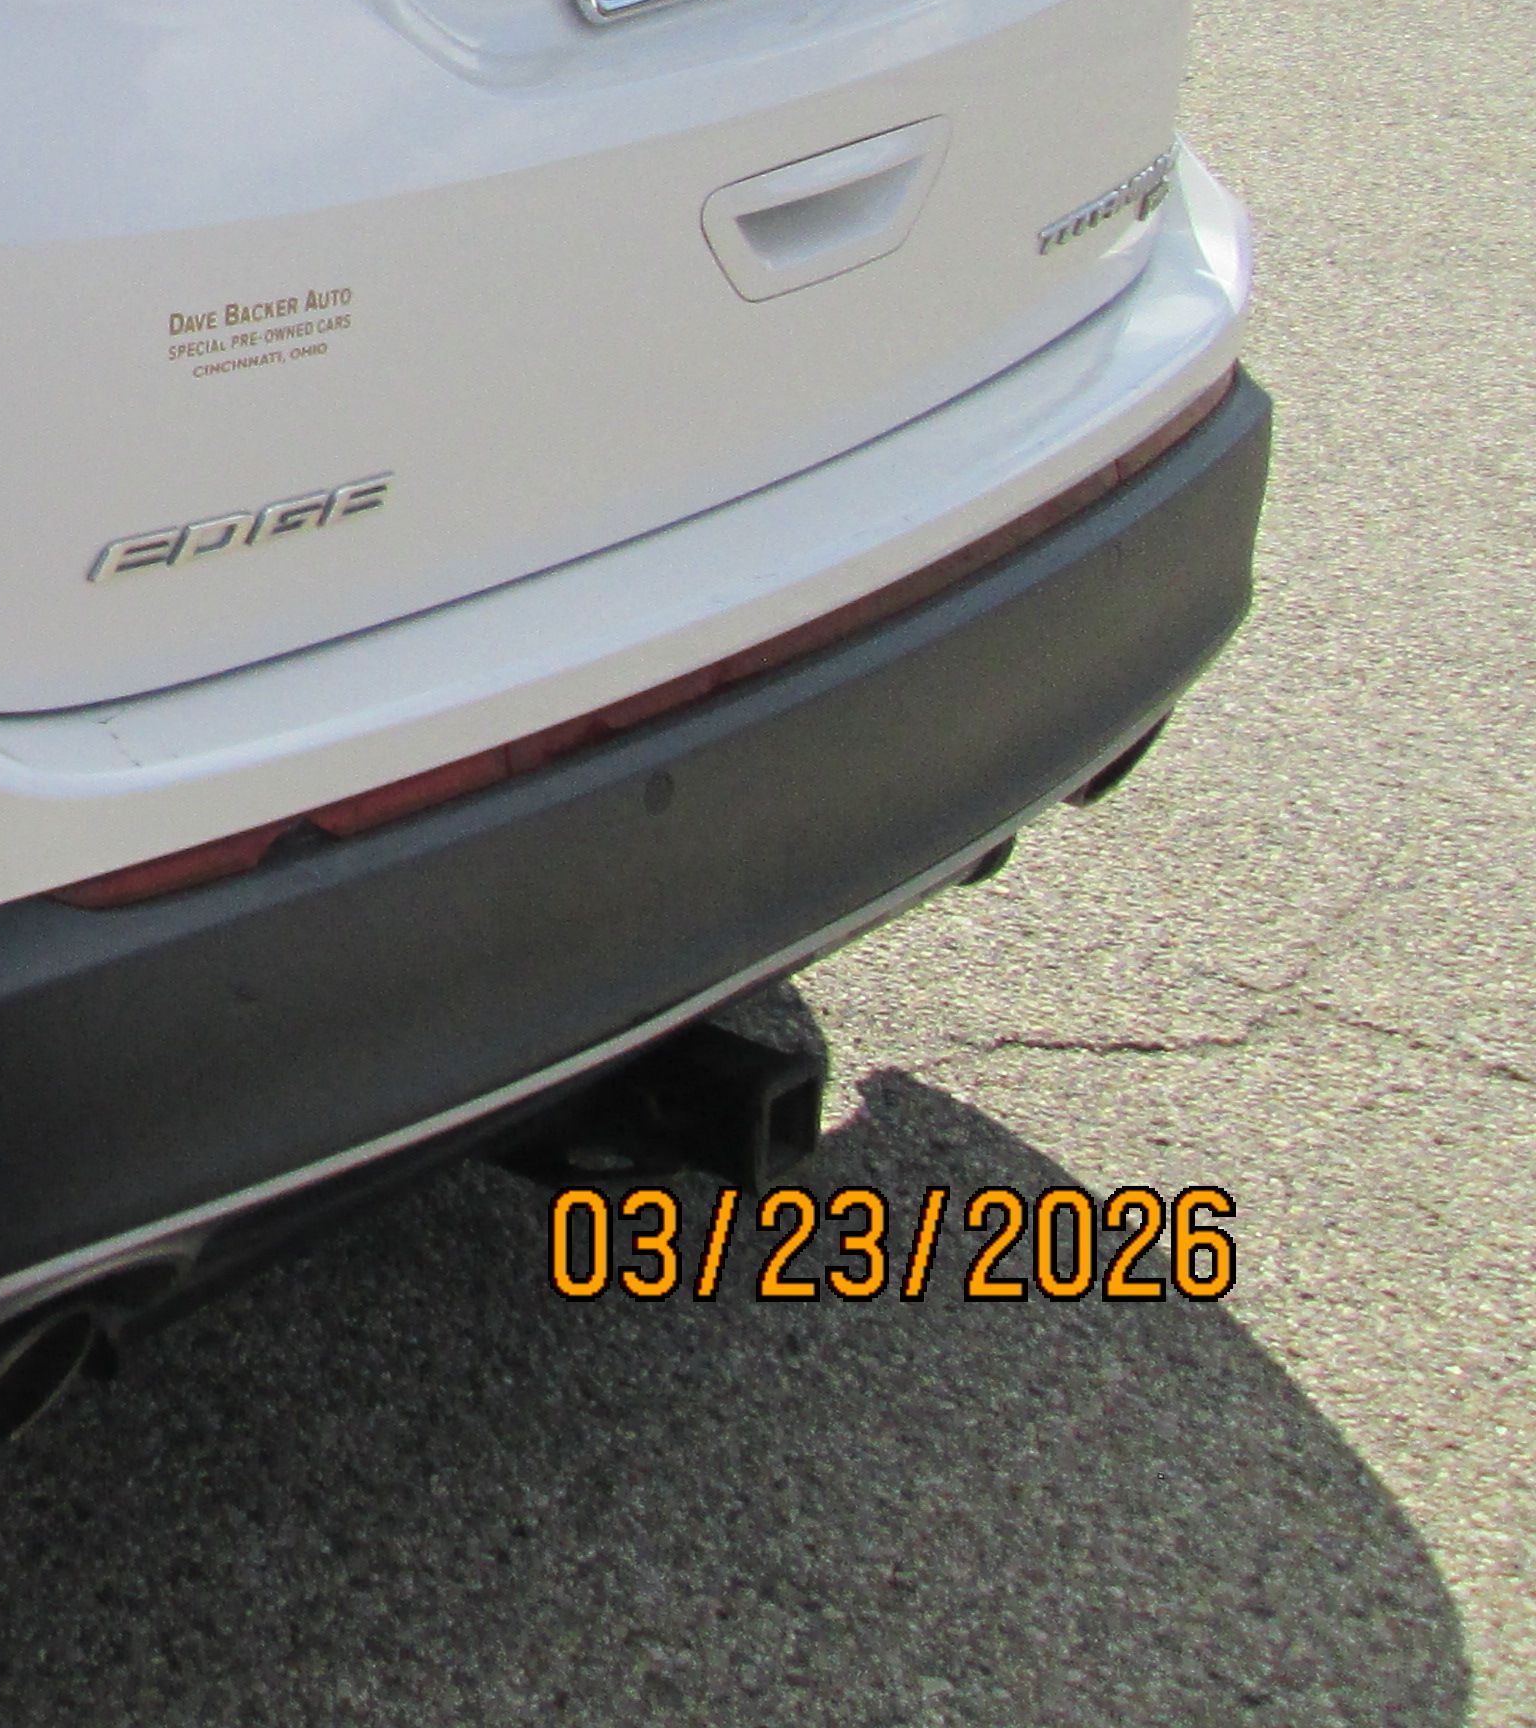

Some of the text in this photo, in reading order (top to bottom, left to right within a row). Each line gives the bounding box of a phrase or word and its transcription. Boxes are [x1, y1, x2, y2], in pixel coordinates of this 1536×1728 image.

[168, 287, 353, 336] DAVE BACKER AUTO
[168, 314, 352, 361] SPECIAL PRE-OWNED CARS
[192, 342, 329, 379] CINCINNATI, OHIO
[85, 468, 396, 584] EDGE
